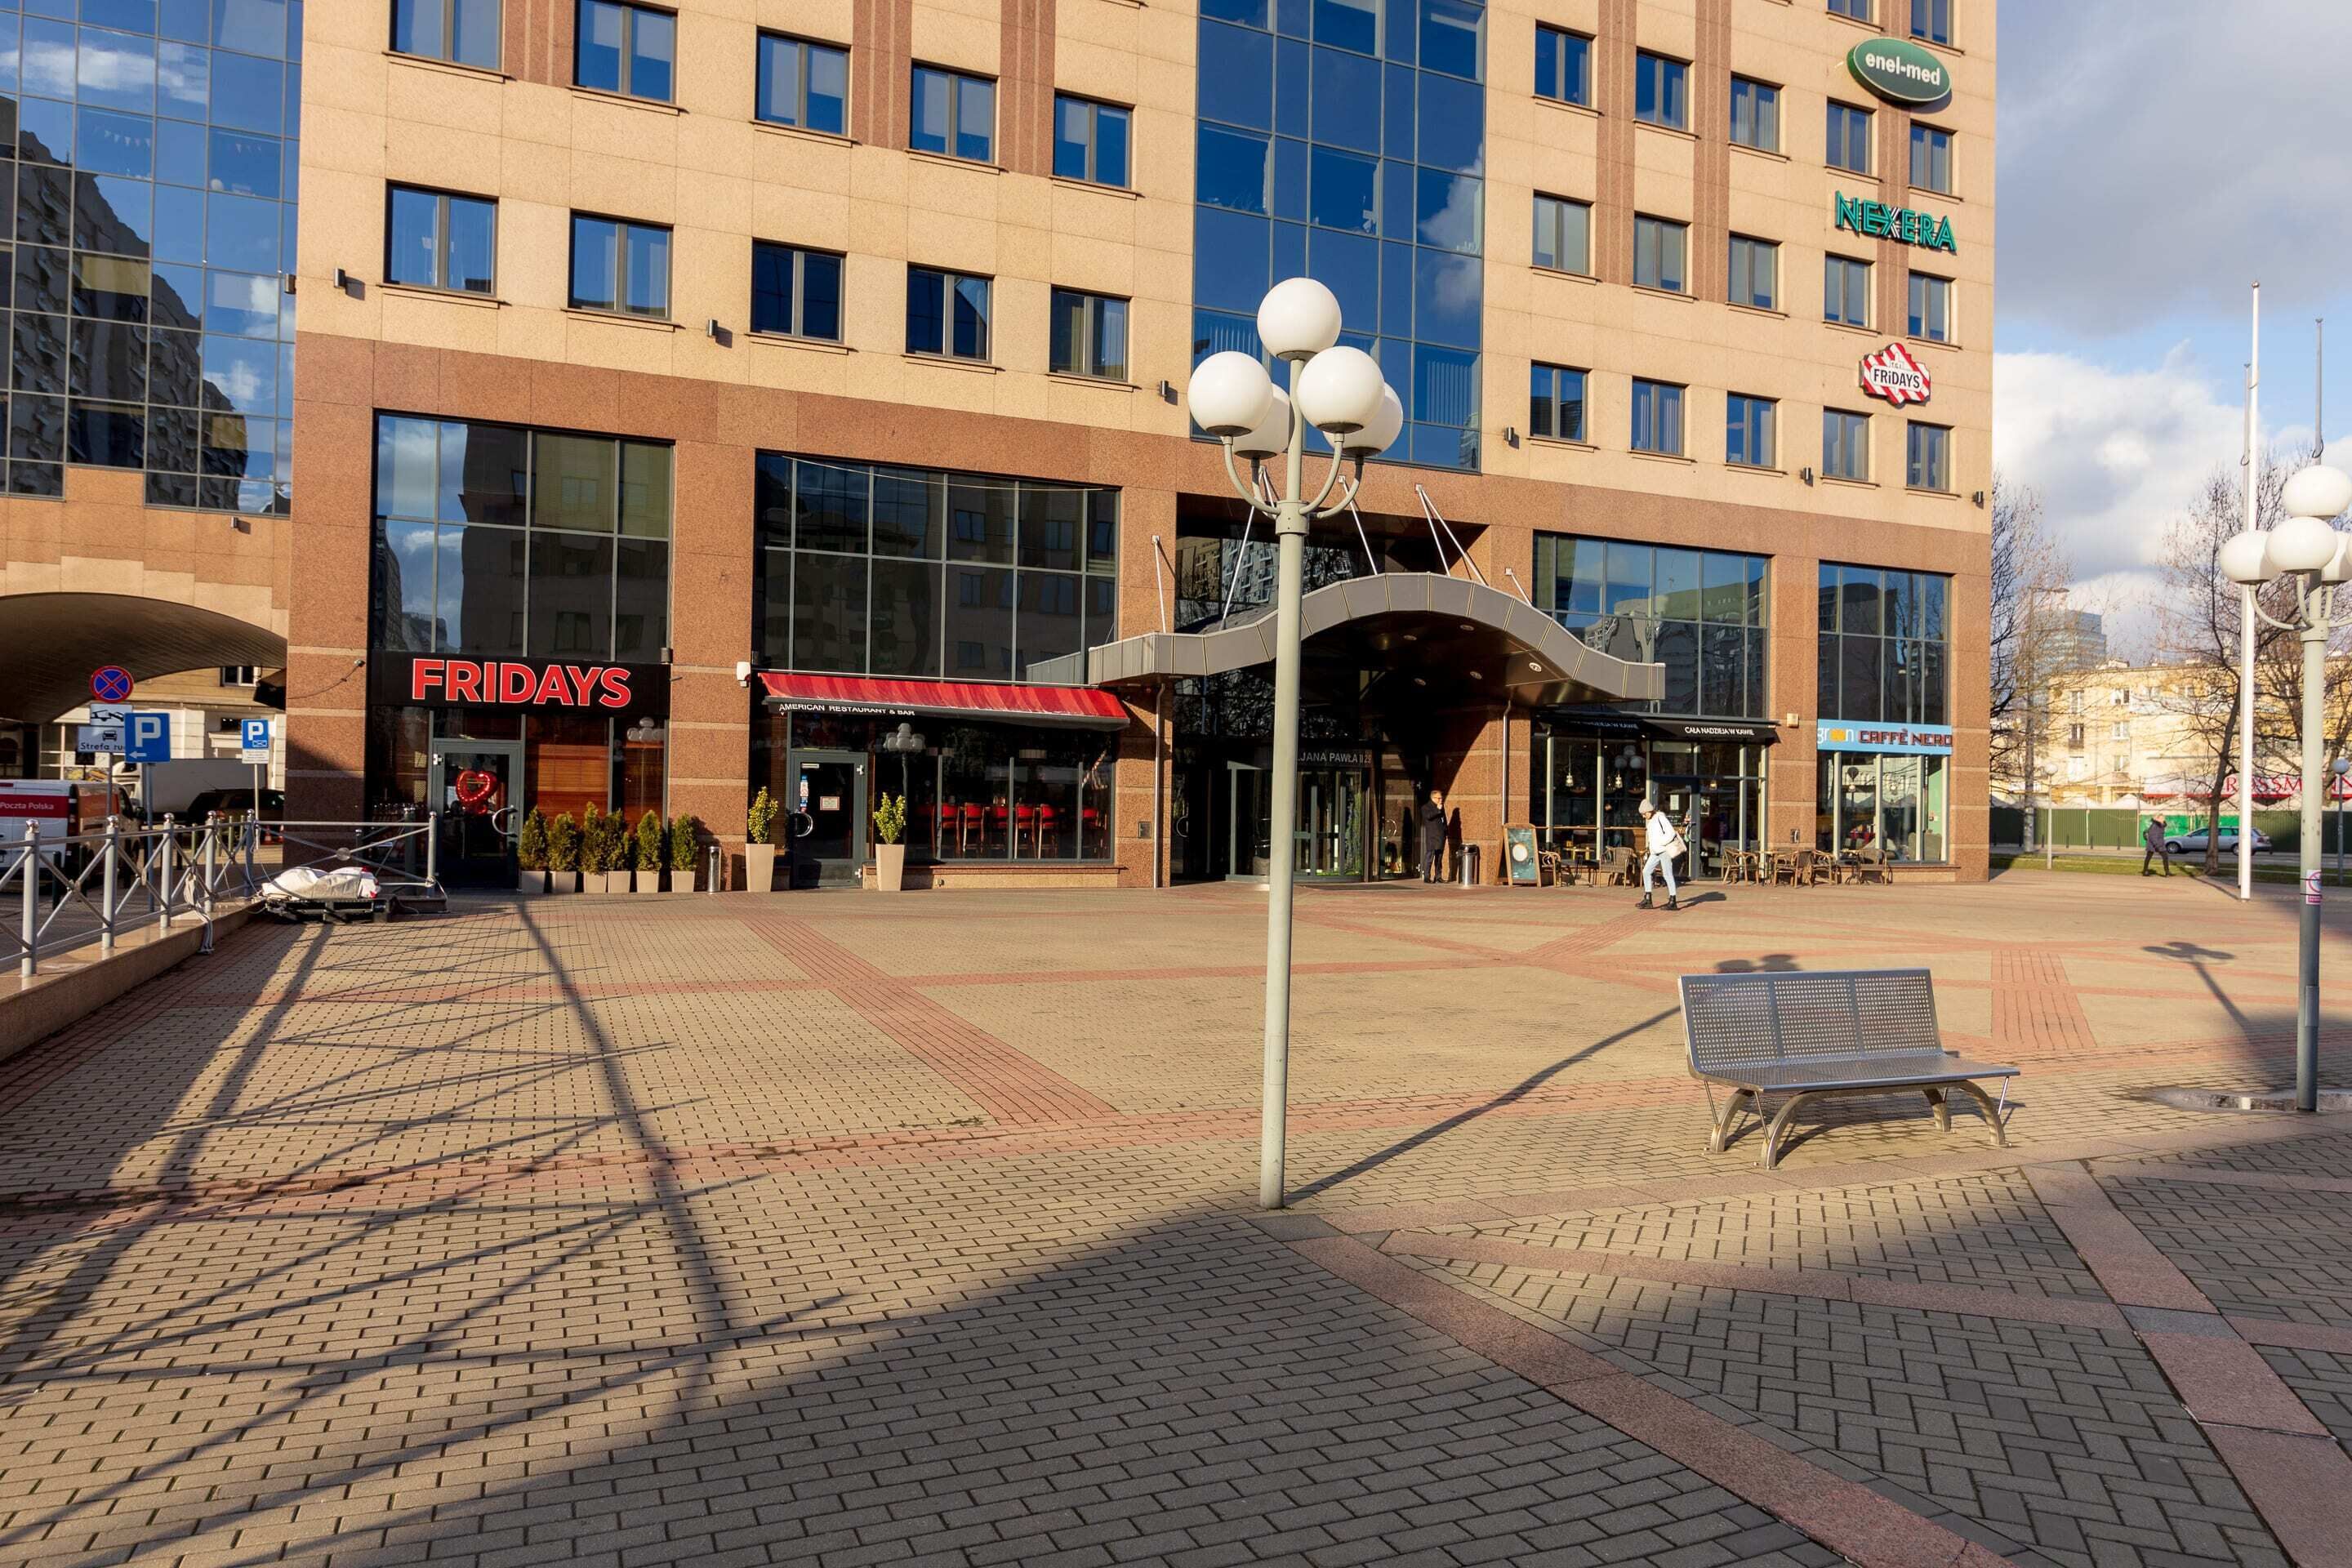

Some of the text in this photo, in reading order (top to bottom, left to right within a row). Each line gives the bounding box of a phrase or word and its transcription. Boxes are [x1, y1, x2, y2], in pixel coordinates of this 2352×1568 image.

[1865, 52, 1940, 86] enel-med
[1835, 190, 1958, 252] NEXERA
[412, 658, 631, 708] FRIDAYS
[779, 703, 825, 712] AMERICAN
[829, 706, 887, 715] RESTAURANT
[135, 716, 162, 747] P
[247, 721, 264, 741] P
[80, 742, 109, 751] Strefa
[0, 801, 55, 810] Poczta Polska
